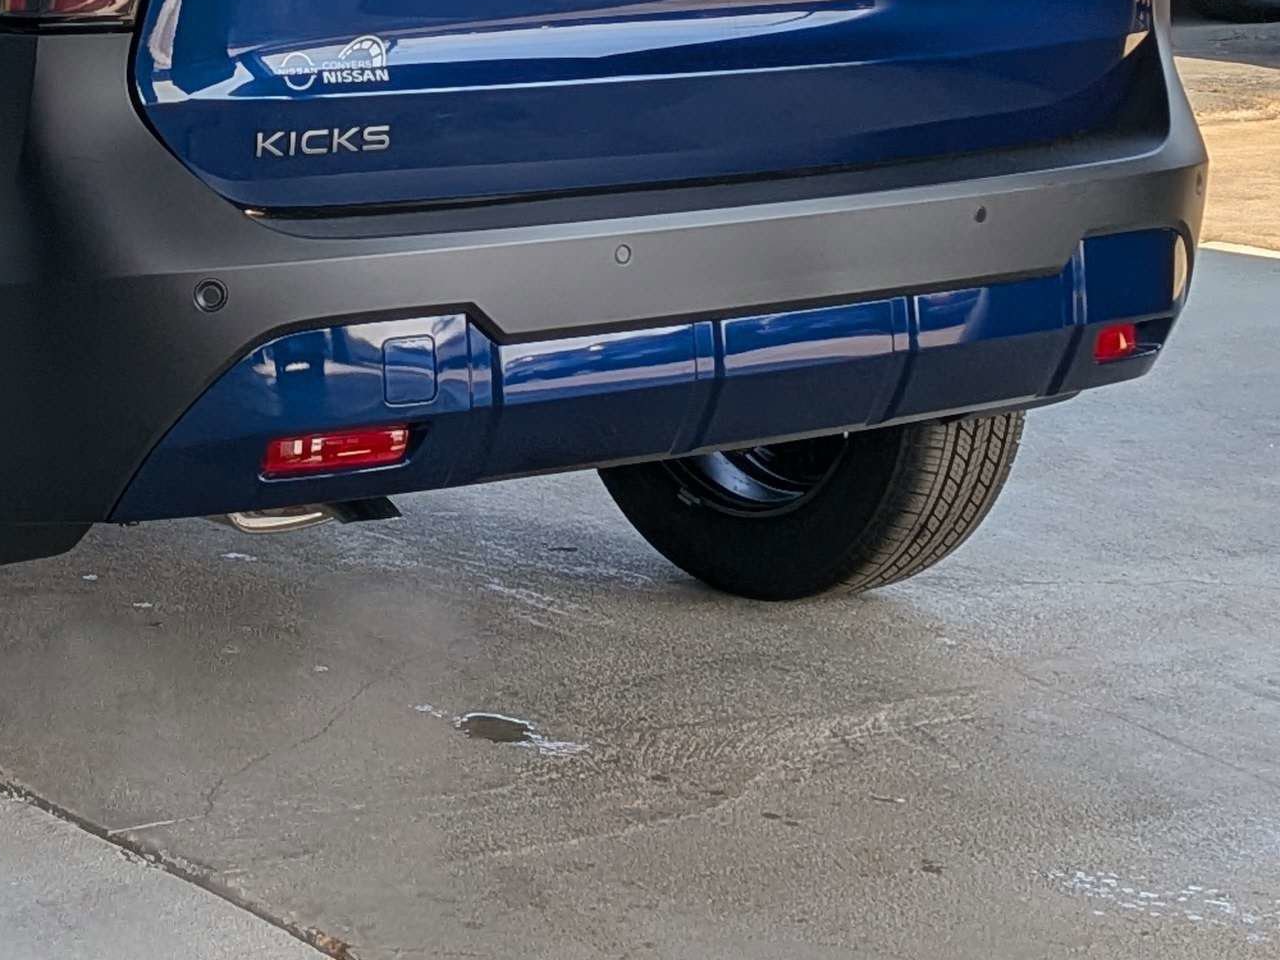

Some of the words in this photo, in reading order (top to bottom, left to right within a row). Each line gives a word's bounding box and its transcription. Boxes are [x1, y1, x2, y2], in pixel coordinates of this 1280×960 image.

[322, 59, 372, 70] CONYERS
[322, 68, 390, 84] NISSAN
[255, 125, 391, 158] KICKS
